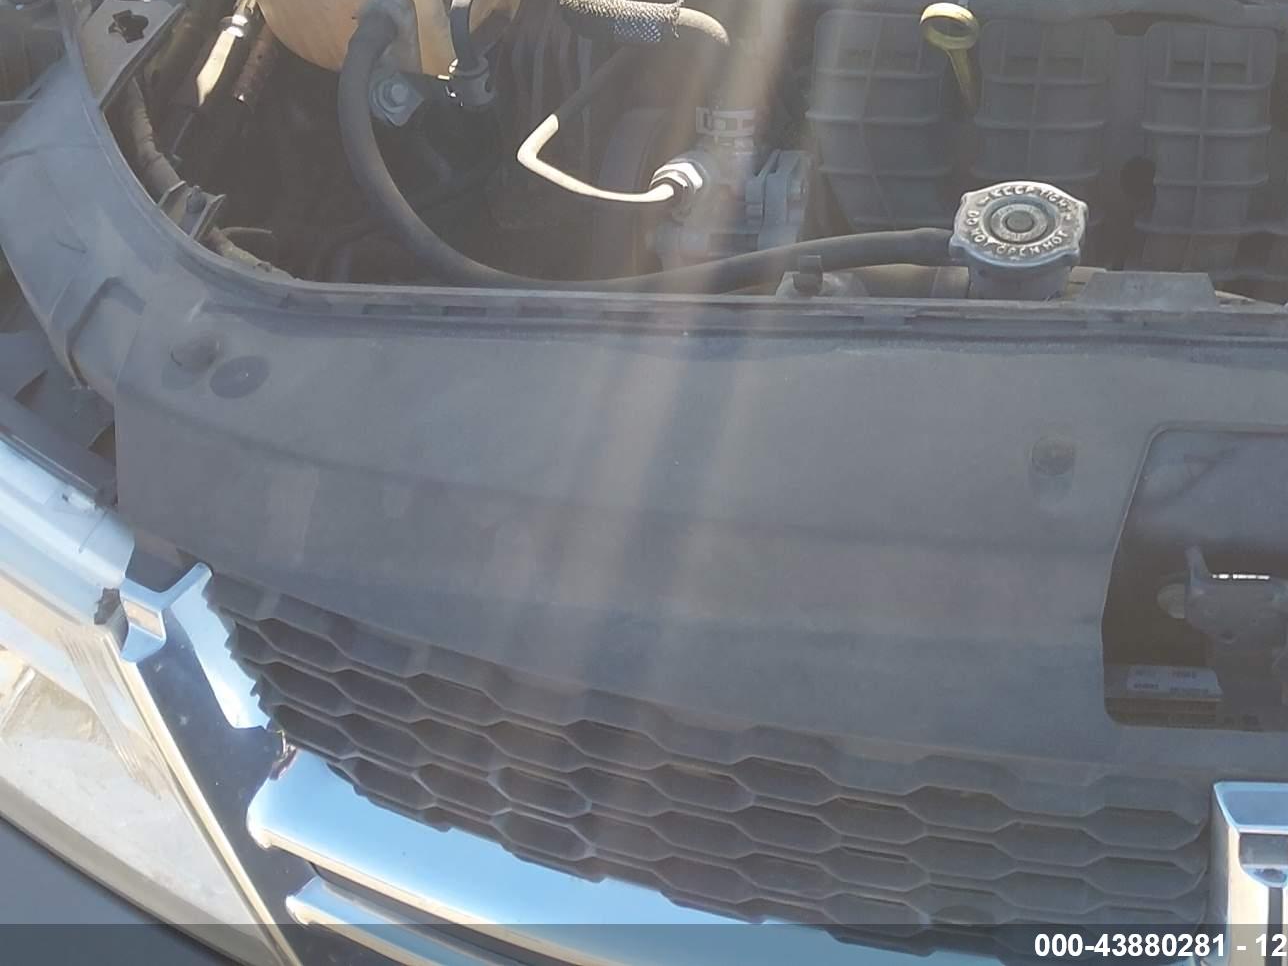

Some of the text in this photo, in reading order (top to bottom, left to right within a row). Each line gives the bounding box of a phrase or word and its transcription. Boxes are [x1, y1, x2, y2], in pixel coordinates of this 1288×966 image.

[971, 228, 994, 246] NOT
[995, 244, 1041, 257] OPEN
[1042, 230, 1068, 249] HOT
